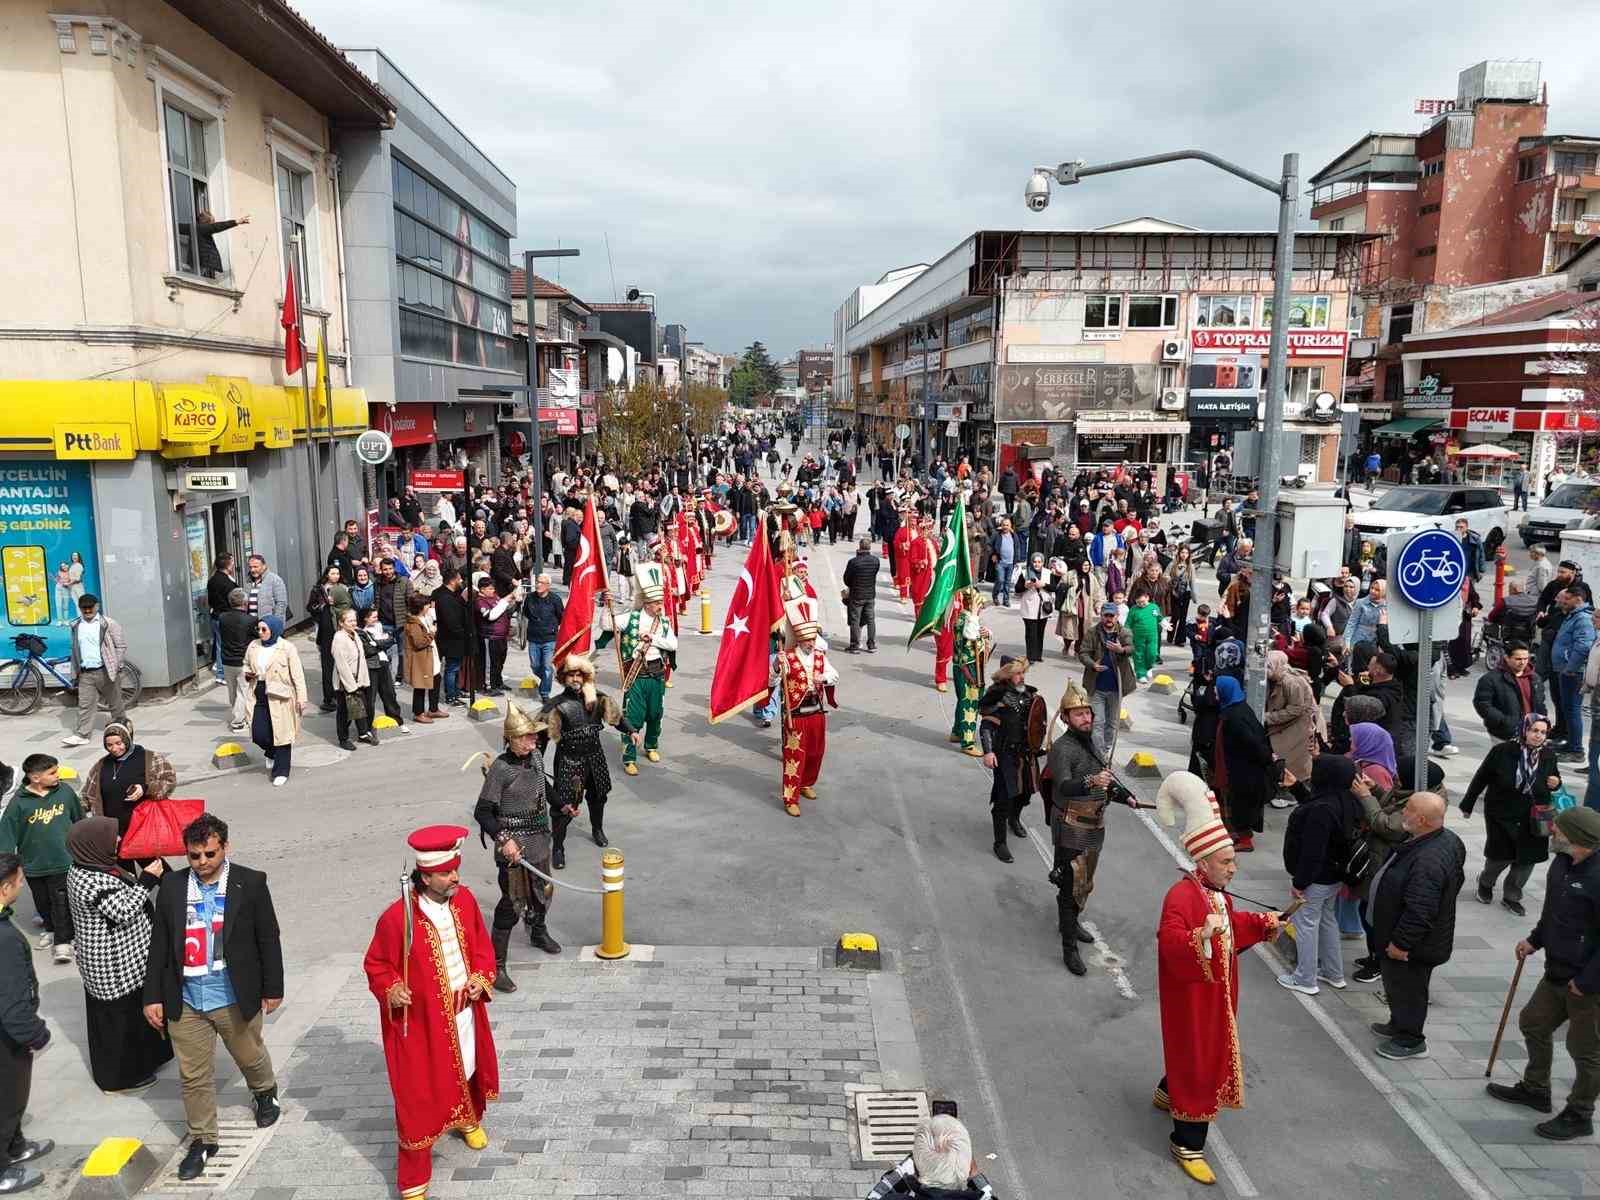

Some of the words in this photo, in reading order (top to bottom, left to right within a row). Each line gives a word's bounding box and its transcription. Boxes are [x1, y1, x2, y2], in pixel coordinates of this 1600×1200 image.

[1212, 333, 1271, 347] TOPRA
[1287, 332, 1345, 347] TURİZM
[201, 401, 216, 412] Ptt
[173, 413, 217, 426] KARGO
[237, 406, 251, 428] Ptt
[1469, 409, 1510, 423] ECZANE
[64, 432, 122, 451] PttBank
[361, 441, 385, 451] UPT
[10, 518, 72, 530] GELDİNİZ
